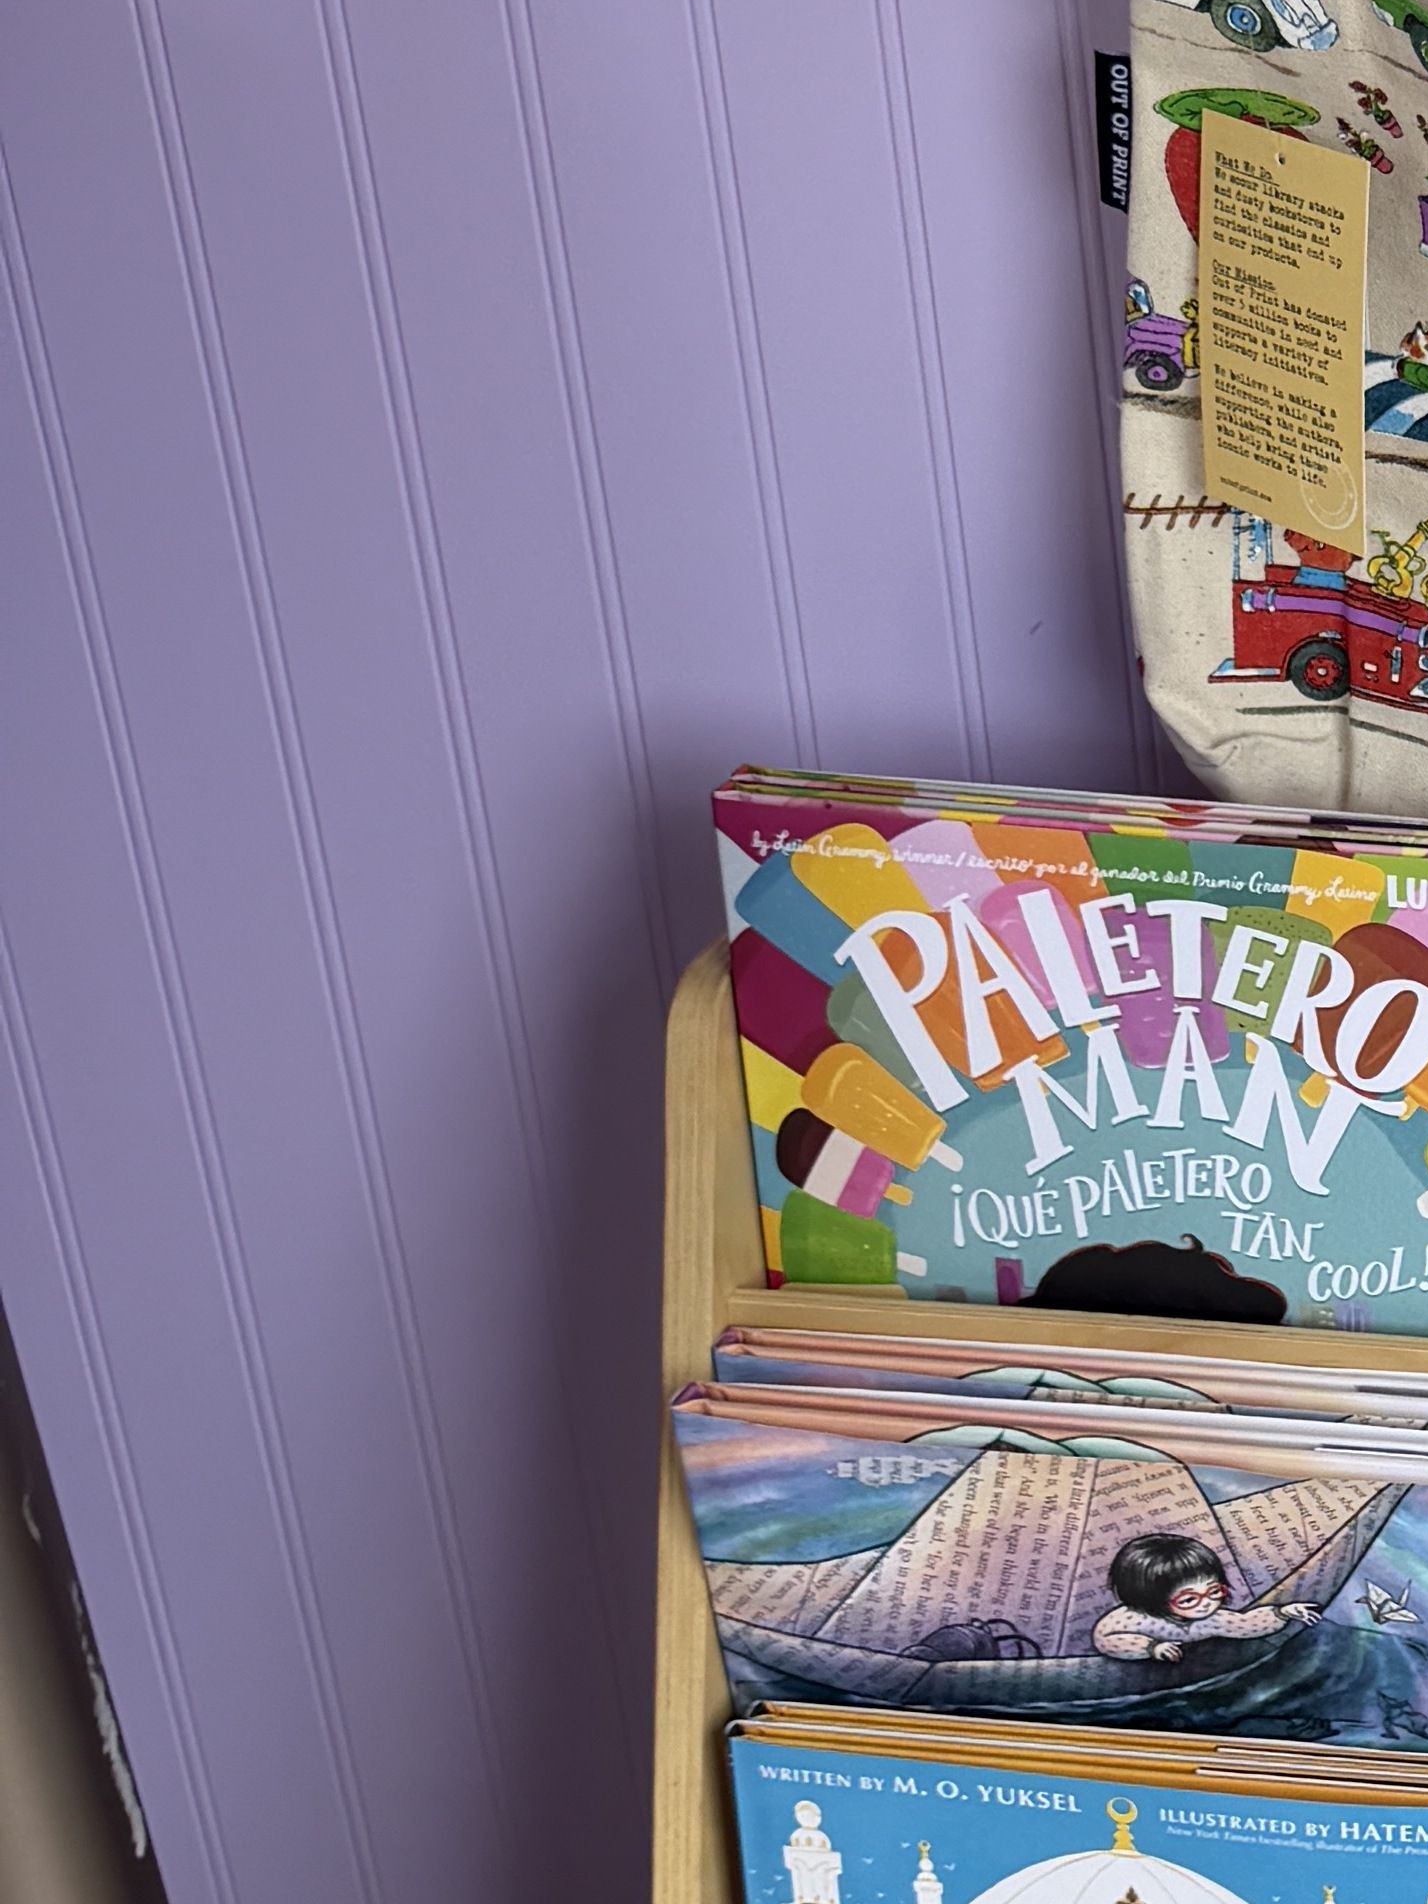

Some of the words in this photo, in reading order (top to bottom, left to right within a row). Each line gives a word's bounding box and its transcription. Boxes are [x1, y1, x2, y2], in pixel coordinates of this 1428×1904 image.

[1110, 64, 1129, 109] OUT
[1111, 112, 1129, 141] OF
[1112, 145, 1129, 206] PRINT
[1002, 1006, 1360, 1196] MAN
[951, 1173, 1064, 1250] ¡QUÉ
[1068, 1150, 1275, 1238] PALETERO
[1221, 1208, 1324, 1264] TAN
[758, 1763, 853, 1789] WRITTEN
[976, 1782, 1083, 1815] YUKSEL
[1158, 1808, 1297, 1837] ILLUSTRATED
